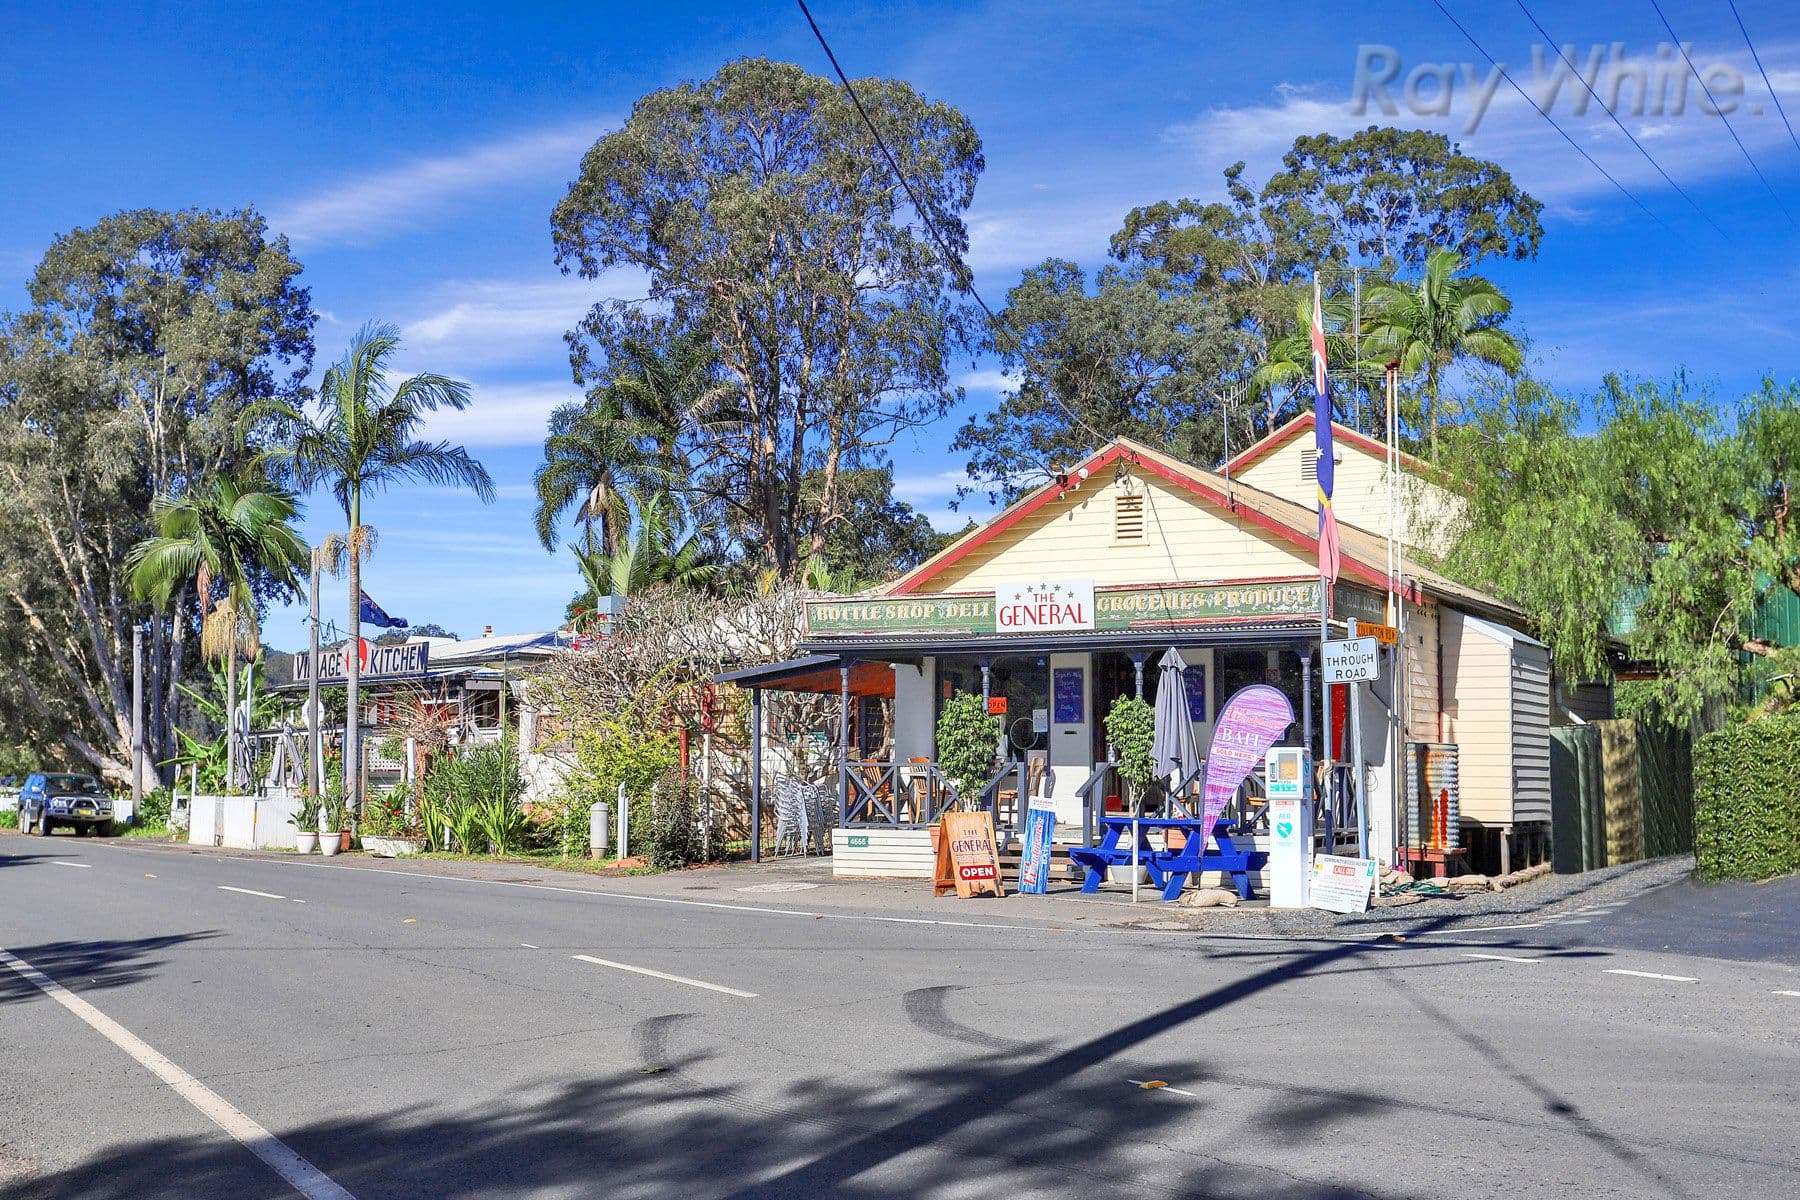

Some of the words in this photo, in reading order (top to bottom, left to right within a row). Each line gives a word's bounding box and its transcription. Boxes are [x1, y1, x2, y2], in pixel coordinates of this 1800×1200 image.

[1033, 593, 1055, 603] THE
[1215, 584, 1308, 606] PRODUCE
[817, 605, 882, 621] BOTTLE
[886, 604, 935, 619] SHOP
[946, 602, 990, 618] DELI
[999, 603, 1088, 626] GENERAL
[1343, 643, 1359, 652] NO
[297, 653, 342, 679] VIAGE
[370, 645, 428, 673] KITCHEN
[1327, 653, 1374, 667] THROUGH
[1336, 668, 1367, 679] ROAD
[1222, 727, 1261, 747] BAIT
[1216, 749, 1234, 757] SOLD
[952, 839, 993, 853] GENERAL
[962, 867, 994, 877] OPEN
